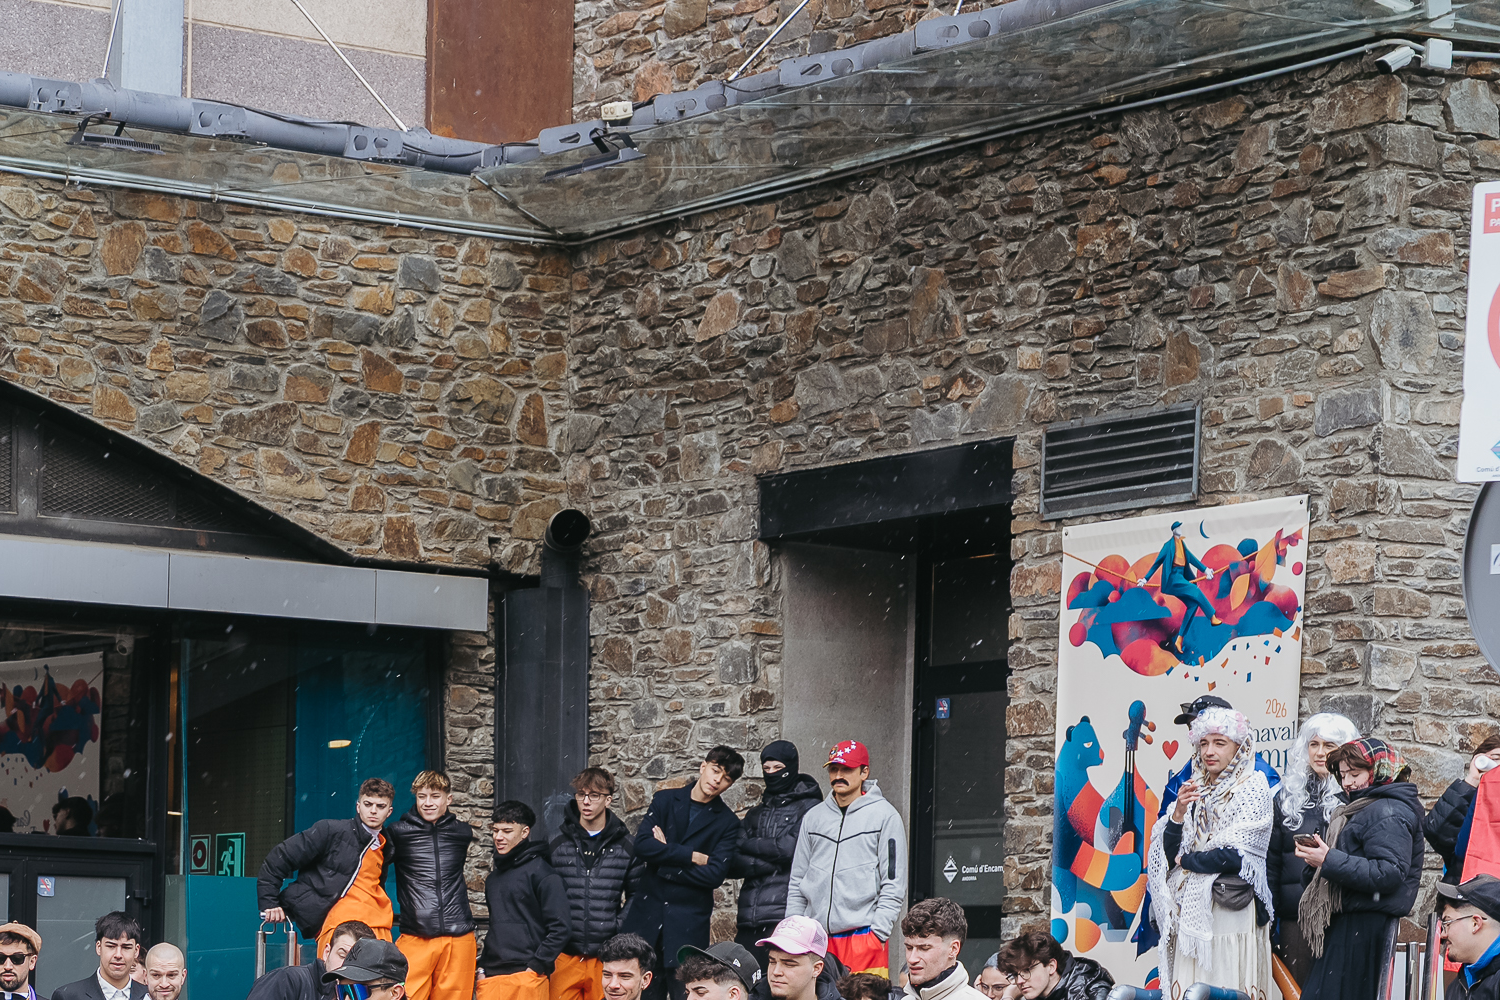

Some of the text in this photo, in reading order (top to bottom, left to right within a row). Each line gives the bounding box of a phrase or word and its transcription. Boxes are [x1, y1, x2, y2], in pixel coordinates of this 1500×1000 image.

[1265, 698, 1287, 718] 2026
[1254, 720, 1296, 742] naval
[961, 864, 1004, 874] Comú d'Encam
